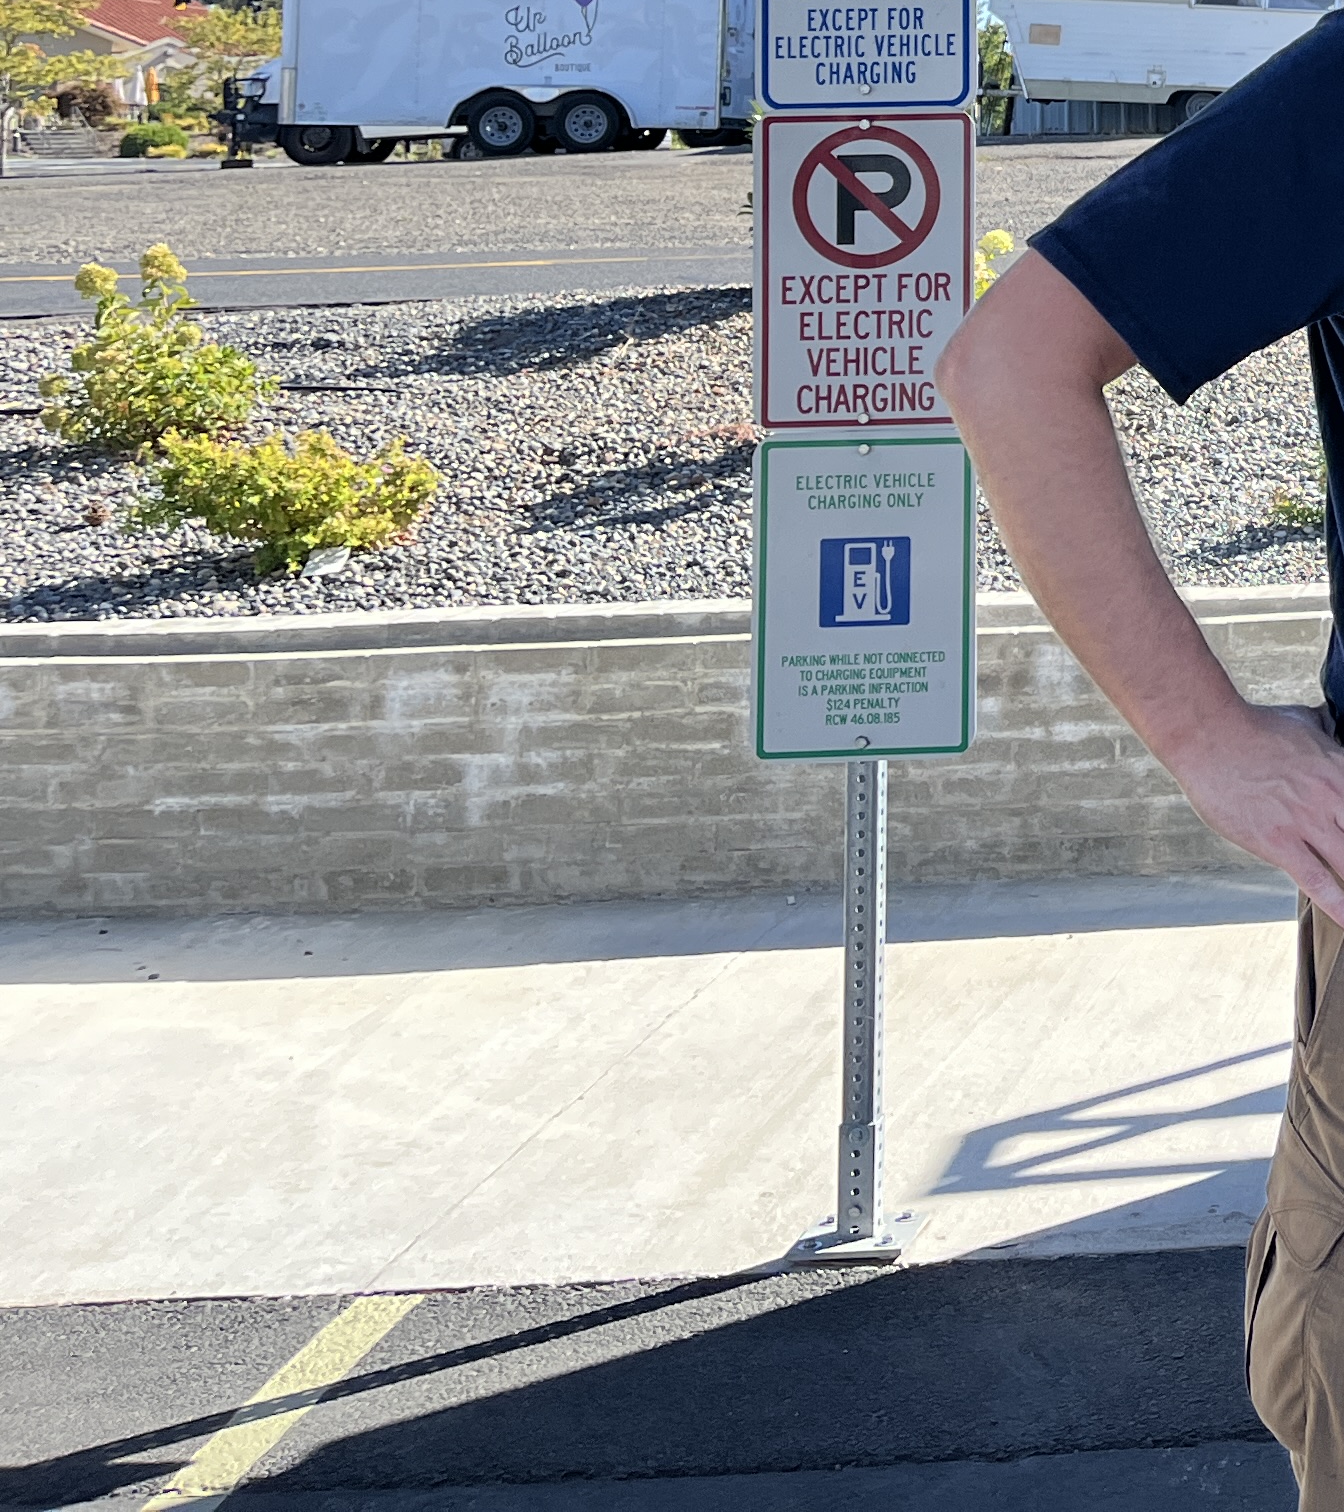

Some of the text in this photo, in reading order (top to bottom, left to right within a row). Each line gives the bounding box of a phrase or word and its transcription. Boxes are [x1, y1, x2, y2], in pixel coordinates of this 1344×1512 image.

[504, 5, 547, 33] Up
[807, 7, 924, 32] EXCEPT FOR
[503, 32, 592, 68] Balloon
[775, 33, 956, 59] ELECTRIC VEHICLE
[554, 63, 591, 72] BOUTIQUE
[815, 61, 916, 86] CHARGING
[781, 272, 951, 305] EXCEPT FOR
[799, 309, 933, 341] ELECTRIC
[806, 345, 924, 377] VEHICLE
[796, 382, 935, 414] CHARGING
[796, 472, 936, 491] ELECTRIC VEHICLE
[807, 492, 924, 510] CHARGING ONLY
[781, 651, 945, 667] PARKING WHILE NOT CONNECTED
[800, 666, 927, 682] TO CHARGING EQUIPMENT
[798, 681, 928, 696] IS A PARKING INFRACTION
[826, 697, 900, 711] $124 PENALTY
[825, 712, 900, 725] RCW 46.08.185
